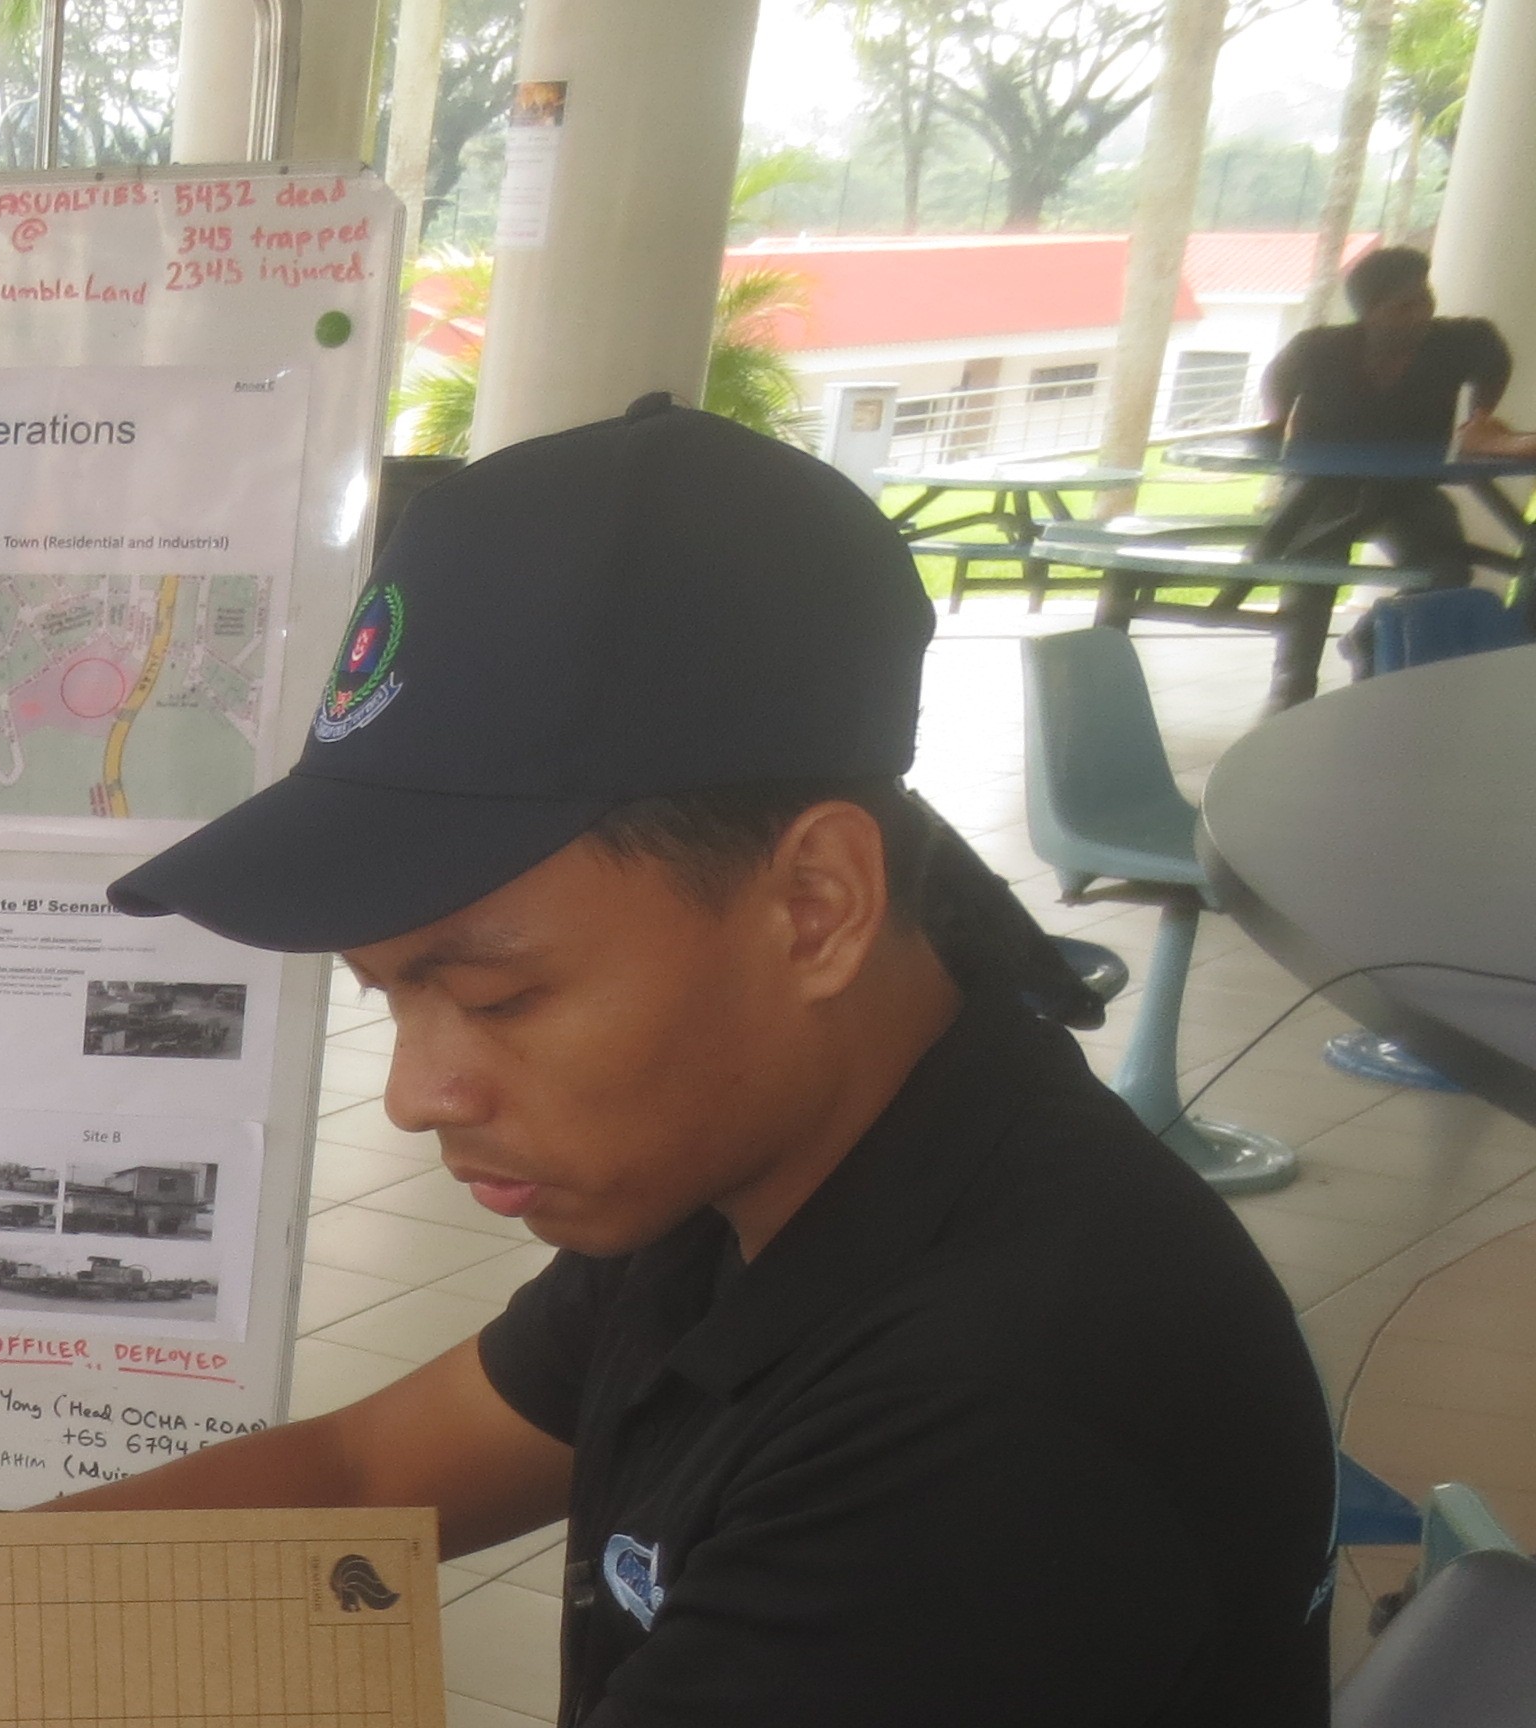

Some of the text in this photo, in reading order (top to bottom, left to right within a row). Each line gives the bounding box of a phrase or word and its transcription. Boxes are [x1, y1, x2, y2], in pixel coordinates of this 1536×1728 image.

[275, 181, 346, 207] dead
[12, 218, 368, 256] @ 345 trapped
[165, 259, 243, 292] 2345
[4, 537, 39, 548] Town
[43, 536, 124, 550] (Residential
[128, 537, 154, 548] and
[158, 537, 229, 550] Industrial)
[83, 1130, 121, 1142] Site B
[115, 1344, 227, 1369] DEPLOYED
[0, 1389, 42, 1419] Yong
[63, 1429, 188, 1454] +65 6794
